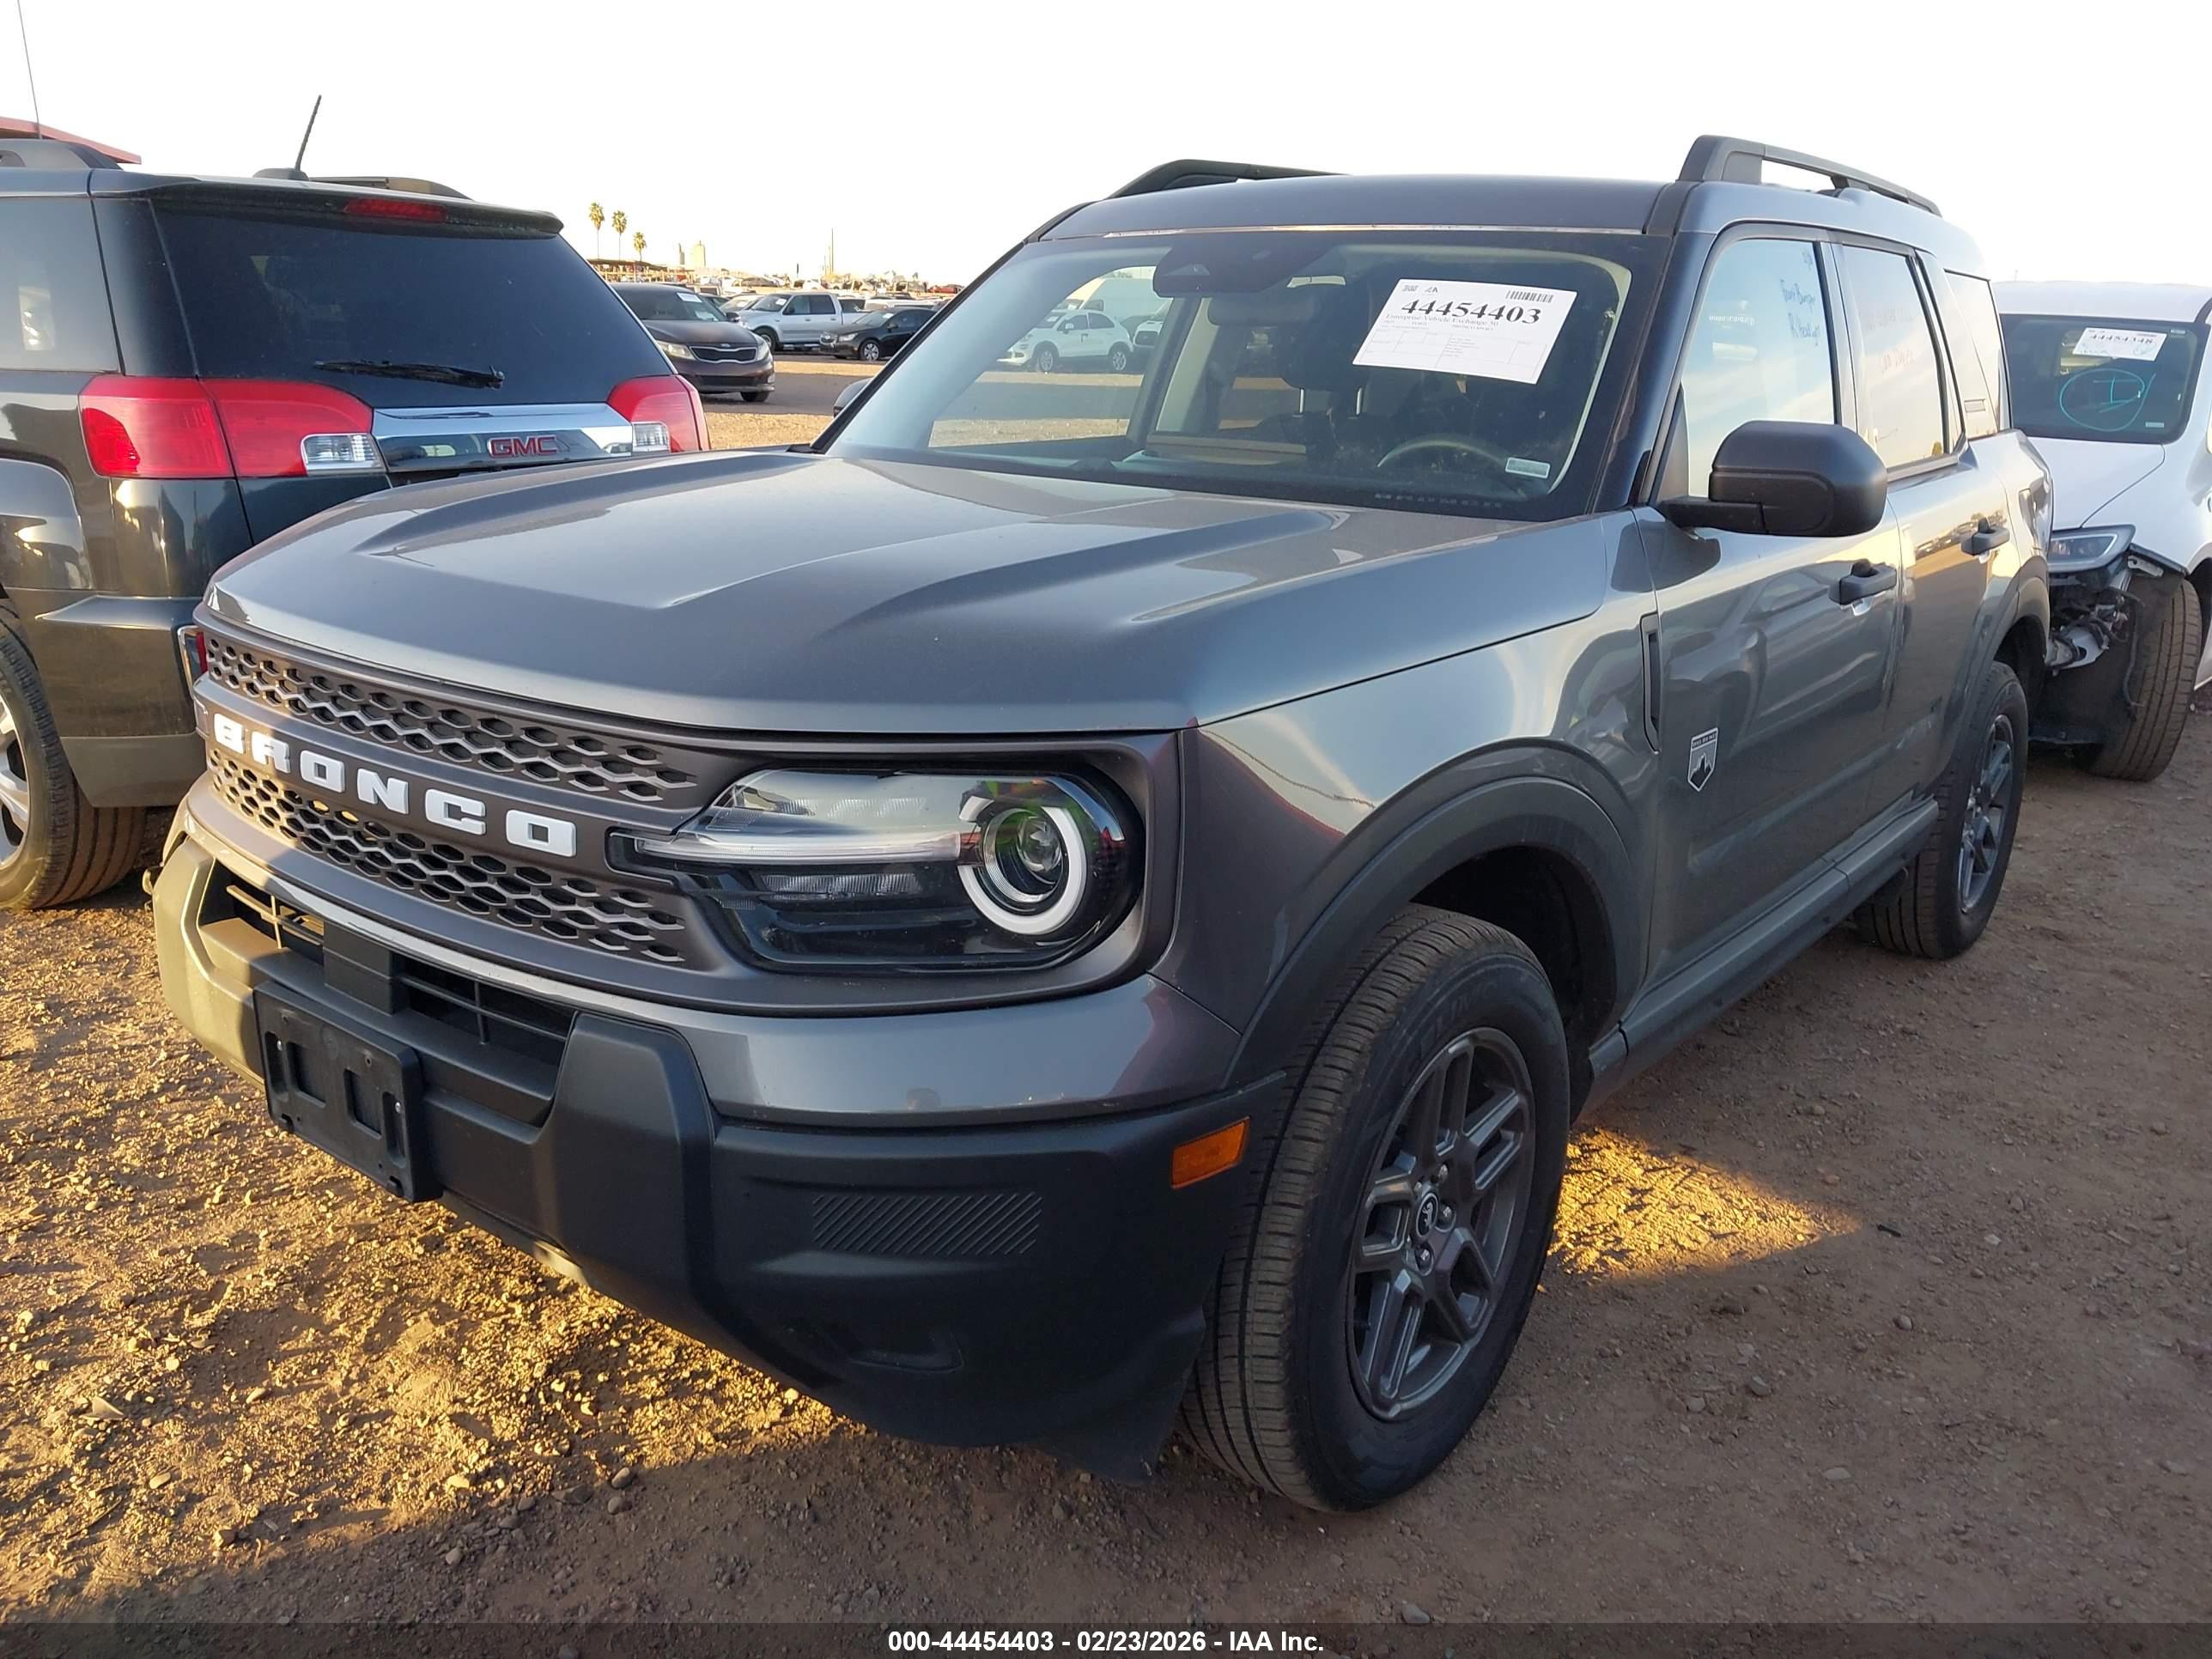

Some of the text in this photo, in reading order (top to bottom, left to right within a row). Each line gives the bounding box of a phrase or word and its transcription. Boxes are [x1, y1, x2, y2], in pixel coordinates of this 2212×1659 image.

[1401, 299, 1541, 325] 44454403
[487, 434, 557, 459] GMC
[213, 712, 579, 858] BRONCO
